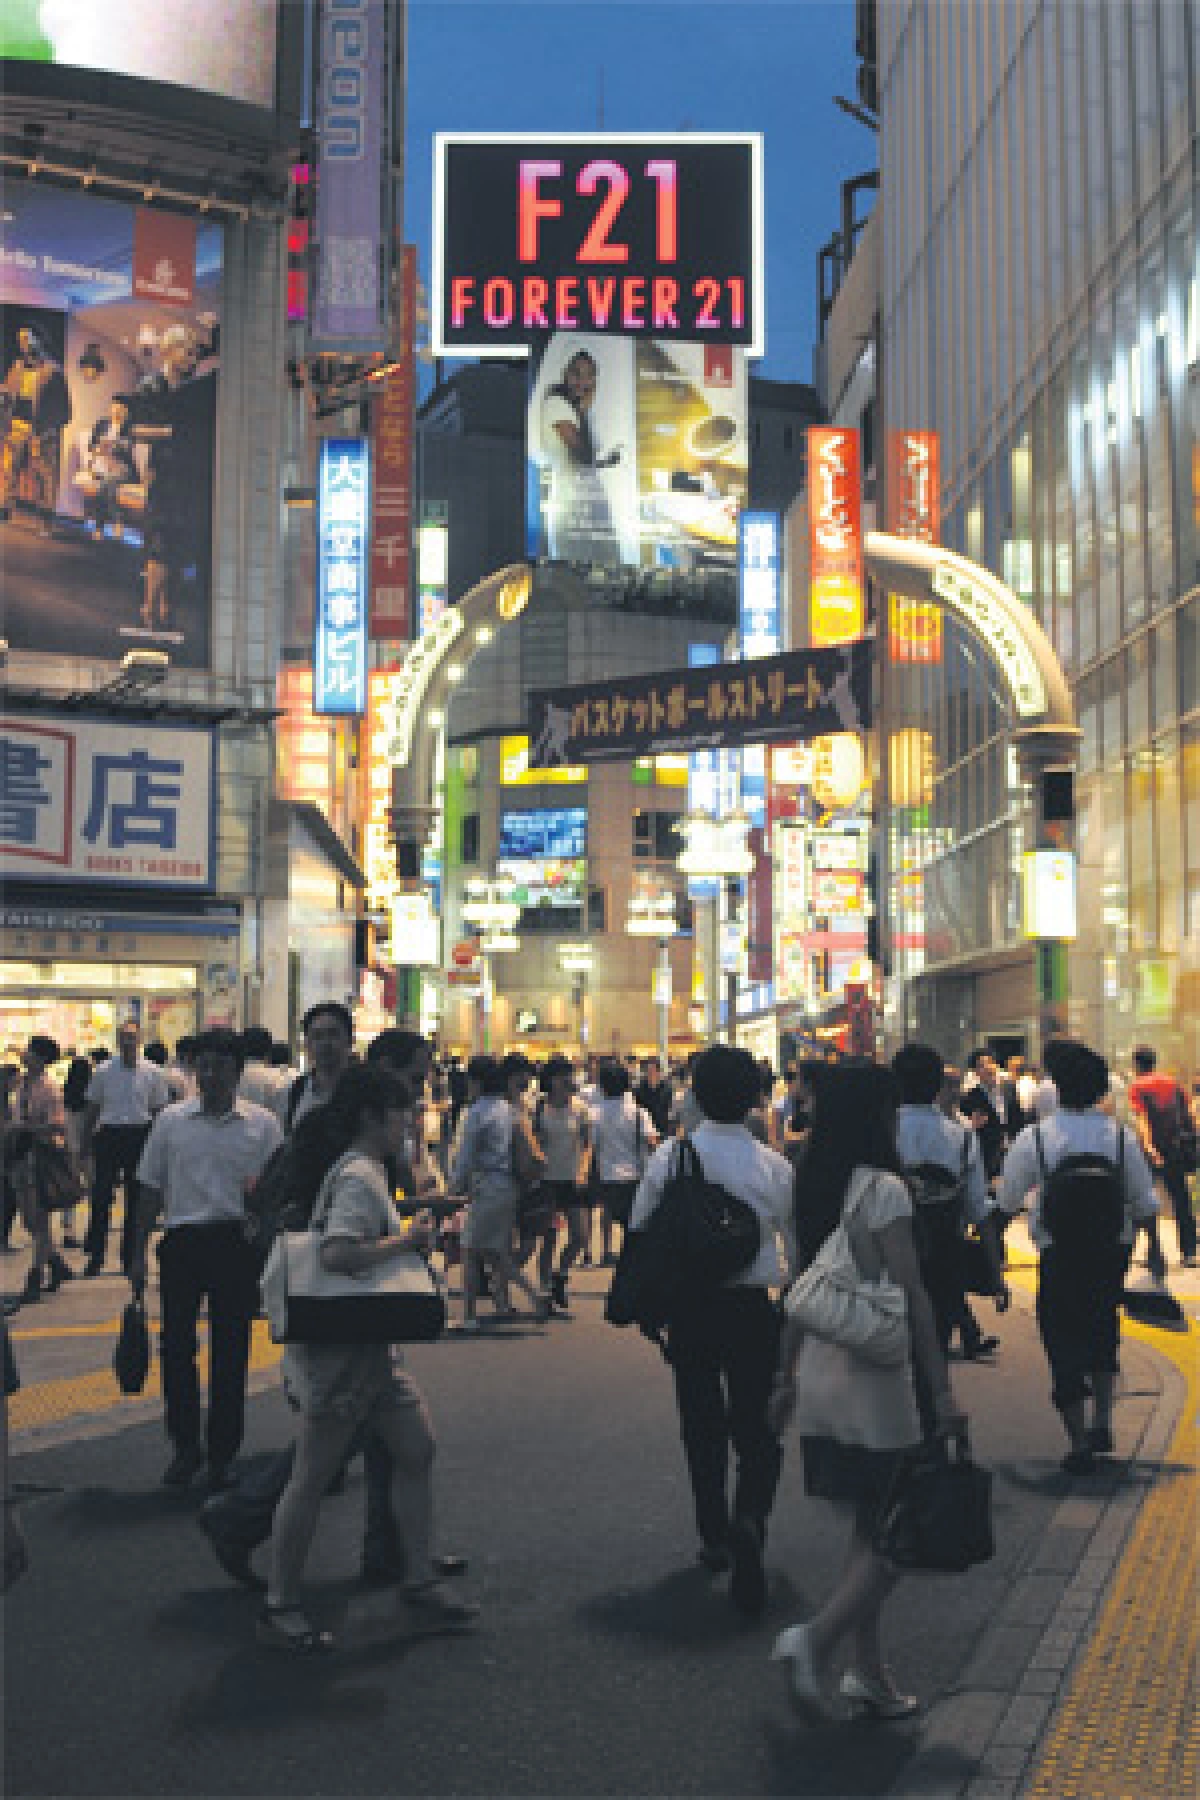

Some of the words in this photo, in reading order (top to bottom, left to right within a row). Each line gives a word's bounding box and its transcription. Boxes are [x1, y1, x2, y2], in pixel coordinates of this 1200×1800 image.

[322, 0, 368, 161] eon
[516, 160, 680, 264] F21
[451, 276, 680, 328] FOREVER
[691, 276, 745, 328] 21
[569, 664, 825, 738] バスケットボールストリート
